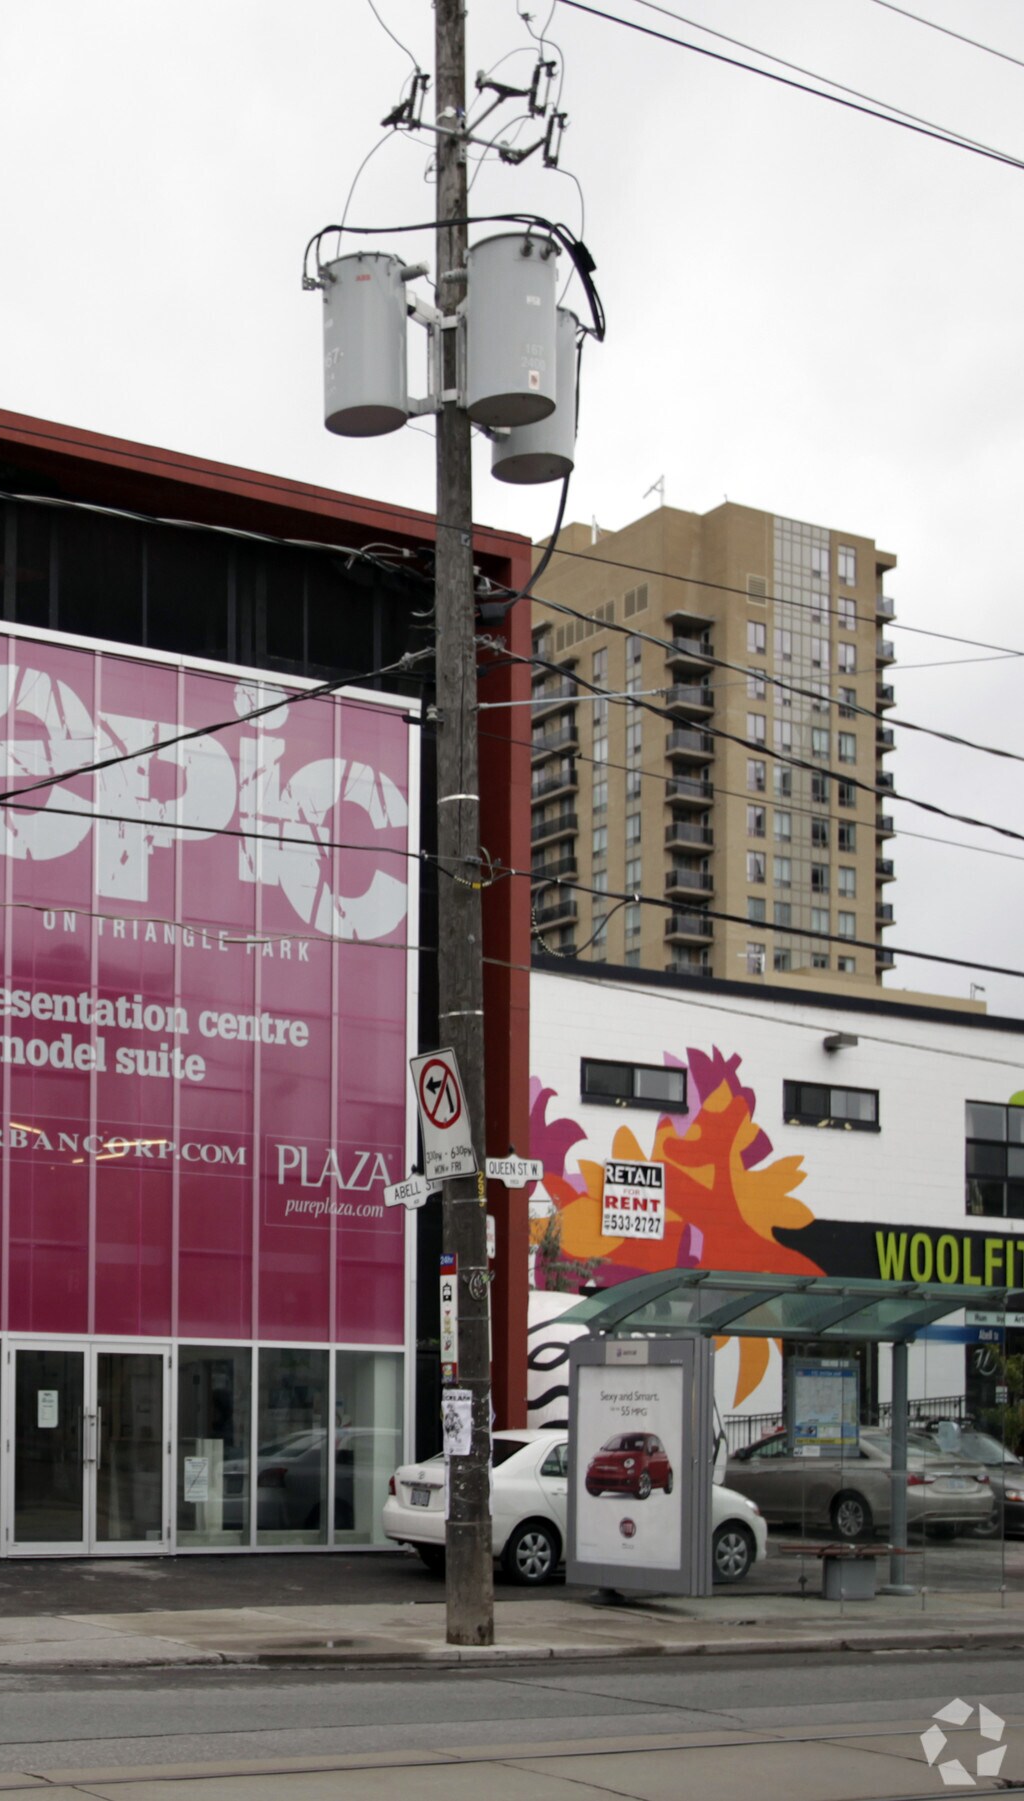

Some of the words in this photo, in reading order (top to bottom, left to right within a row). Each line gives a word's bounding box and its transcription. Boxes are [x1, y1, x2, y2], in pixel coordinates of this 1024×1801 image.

[43, 909, 77, 933] ON
[96, 915, 229, 952] TRIANGLE
[247, 934, 310, 963] PARK
[198, 1006, 310, 1048] centre
[116, 1043, 207, 1082] suite
[275, 1144, 392, 1191] PLAZA
[489, 1161, 515, 1175] QUEEN
[606, 1164, 661, 1187] RETAIL
[394, 1181, 422, 1201] ABELL
[623, 1188, 641, 1196] FOR
[285, 1197, 384, 1218] pureplaza.com
[605, 1195, 661, 1213] RENT
[600, 1390, 618, 1403] Sexy
[619, 1391, 634, 1401] and
